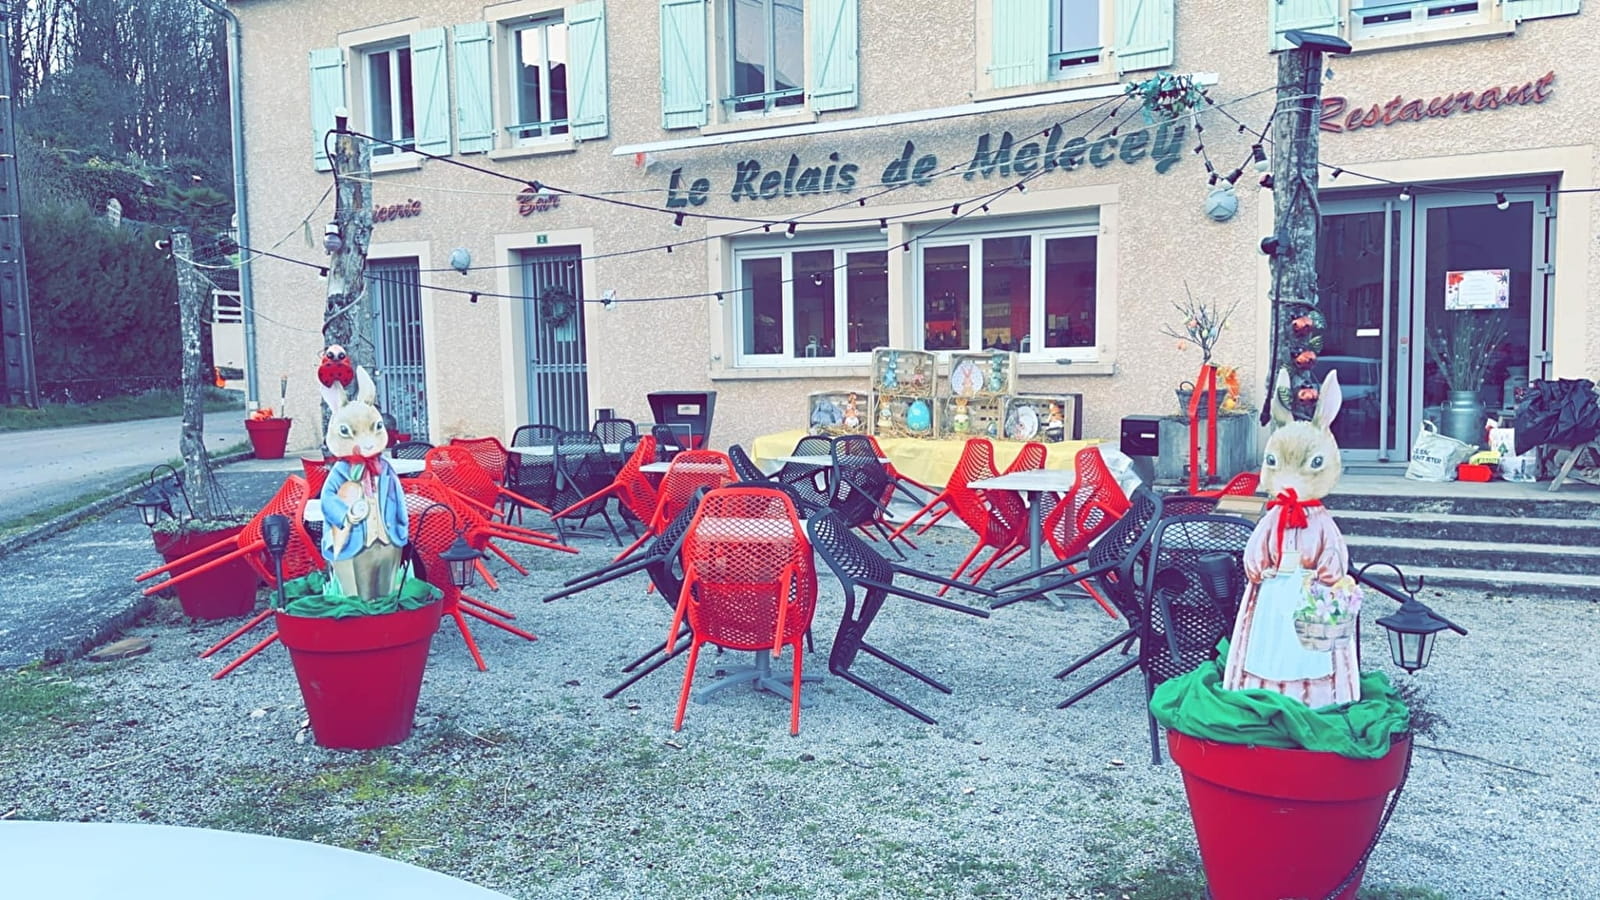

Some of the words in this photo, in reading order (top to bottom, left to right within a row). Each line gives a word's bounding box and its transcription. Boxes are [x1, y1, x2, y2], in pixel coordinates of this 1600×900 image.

[1320, 71, 1556, 133] Restaurant
[666, 168, 709, 208] Le
[732, 151, 858, 202] Relais
[881, 140, 937, 188] de
[963, 122, 1185, 175] Melecey
[372, 198, 421, 223] icerie
[517, 188, 560, 217] Bar
